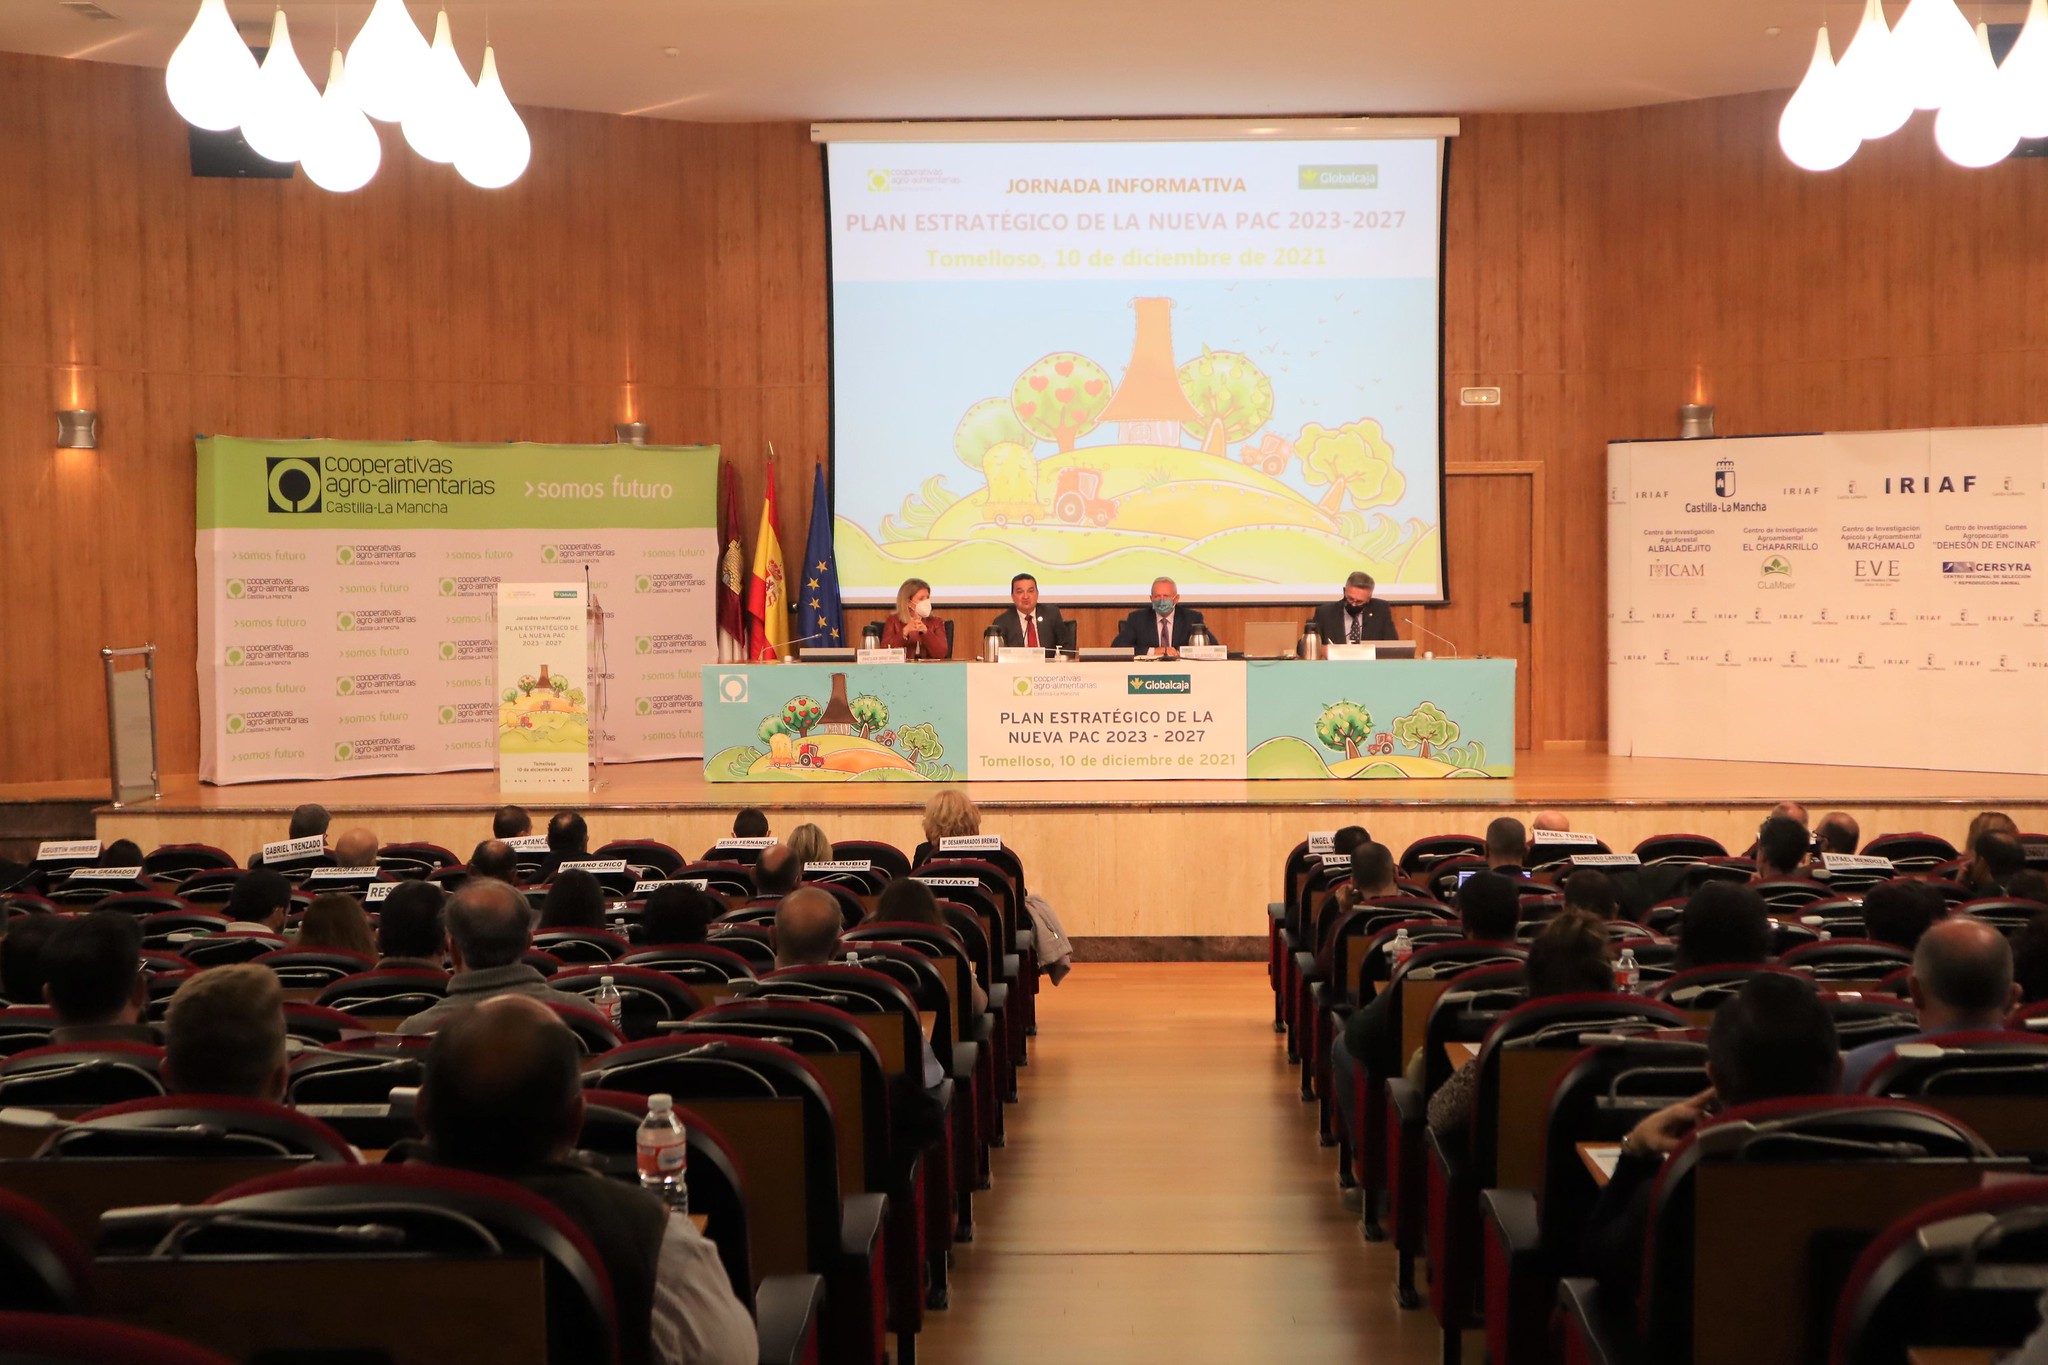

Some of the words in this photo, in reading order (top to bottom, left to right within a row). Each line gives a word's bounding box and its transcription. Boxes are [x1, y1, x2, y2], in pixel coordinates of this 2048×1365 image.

[1320, 172, 1376, 185] Globalcaja
[1006, 179, 1102, 194] JORNADA
[1107, 178, 1247, 193] INFORMATIVA
[846, 214, 906, 232] PLAN
[915, 208, 1069, 232] ESTRATÉGICO
[1077, 213, 1106, 231] DE
[1113, 212, 1141, 230] LA
[1149, 212, 1228, 230] NUEVA
[1235, 211, 1281, 230] PAC
[1288, 210, 1406, 229] 2023-2027
[926, 249, 1048, 270] Tomelloso,
[1055, 249, 1081, 267] 10
[1087, 248, 1115, 267] de
[1121, 247, 1232, 267] diciembre
[1238, 247, 1266, 266] de
[1272, 248, 1327, 266] 2021
[324, 456, 453, 476] cooperativas
[326, 476, 496, 498] agro-alimentarias
[612, 474, 673, 499] futuro
[1886, 475, 1976, 494] IRIAF
[1636, 490, 1670, 499] IRIAF
[1783, 487, 1820, 495] IRIAF
[326, 501, 394, 514] Castilla-La
[396, 501, 449, 514] Mancha
[1733, 501, 1767, 512] Mancha
[1648, 544, 1712, 553] ALBALADEJITO
[1756, 543, 1818, 551] CHAPARRILLO
[1848, 541, 1915, 550] MARCHAMALO
[1981, 541, 1994, 549] DE
[275, 550, 306, 561] futuro
[485, 550, 512, 559] futuro
[679, 548, 705, 557] futuro
[1855, 560, 1900, 577] EVE
[1976, 563, 2032, 572] CERSYRA
[247, 578, 293, 586] cooperativas
[380, 582, 409, 593] futuro
[276, 616, 306, 627] futuro
[246, 644, 293, 652] cooperativas
[380, 647, 409, 657] futuro
[356, 674, 401, 682] cooperativas
[276, 683, 306, 694] futuro
[1144, 680, 1190, 692] Globalcaja
[246, 710, 293, 718] cooperativas
[380, 710, 409, 722] futuro
[1000, 712, 1044, 724] PLAN
[1050, 708, 1161, 724] ESTRATÉGICO
[1166, 712, 1188, 724] DE
[1193, 711, 1214, 723] LA
[355, 737, 400, 746] cooperativas
[1008, 732, 1064, 744] NUEVA
[1069, 731, 1100, 744] PAC
[1106, 731, 1148, 743] 2023
[1164, 730, 1206, 742] 2027
[274, 748, 305, 760] futuro
[980, 754, 1055, 769] Tomelloso,
[1060, 754, 1076, 767] 10
[1080, 754, 1098, 767] de
[1102, 754, 1172, 767] diciembre
[1178, 754, 1195, 766] de
[1200, 754, 1236, 766] 2021
[266, 844, 290, 856] GABRIEL
[290, 840, 320, 852] TRENZADO
[1826, 854, 1853, 864] RAFAEL
[1854, 857, 1888, 866] MENDOZA
